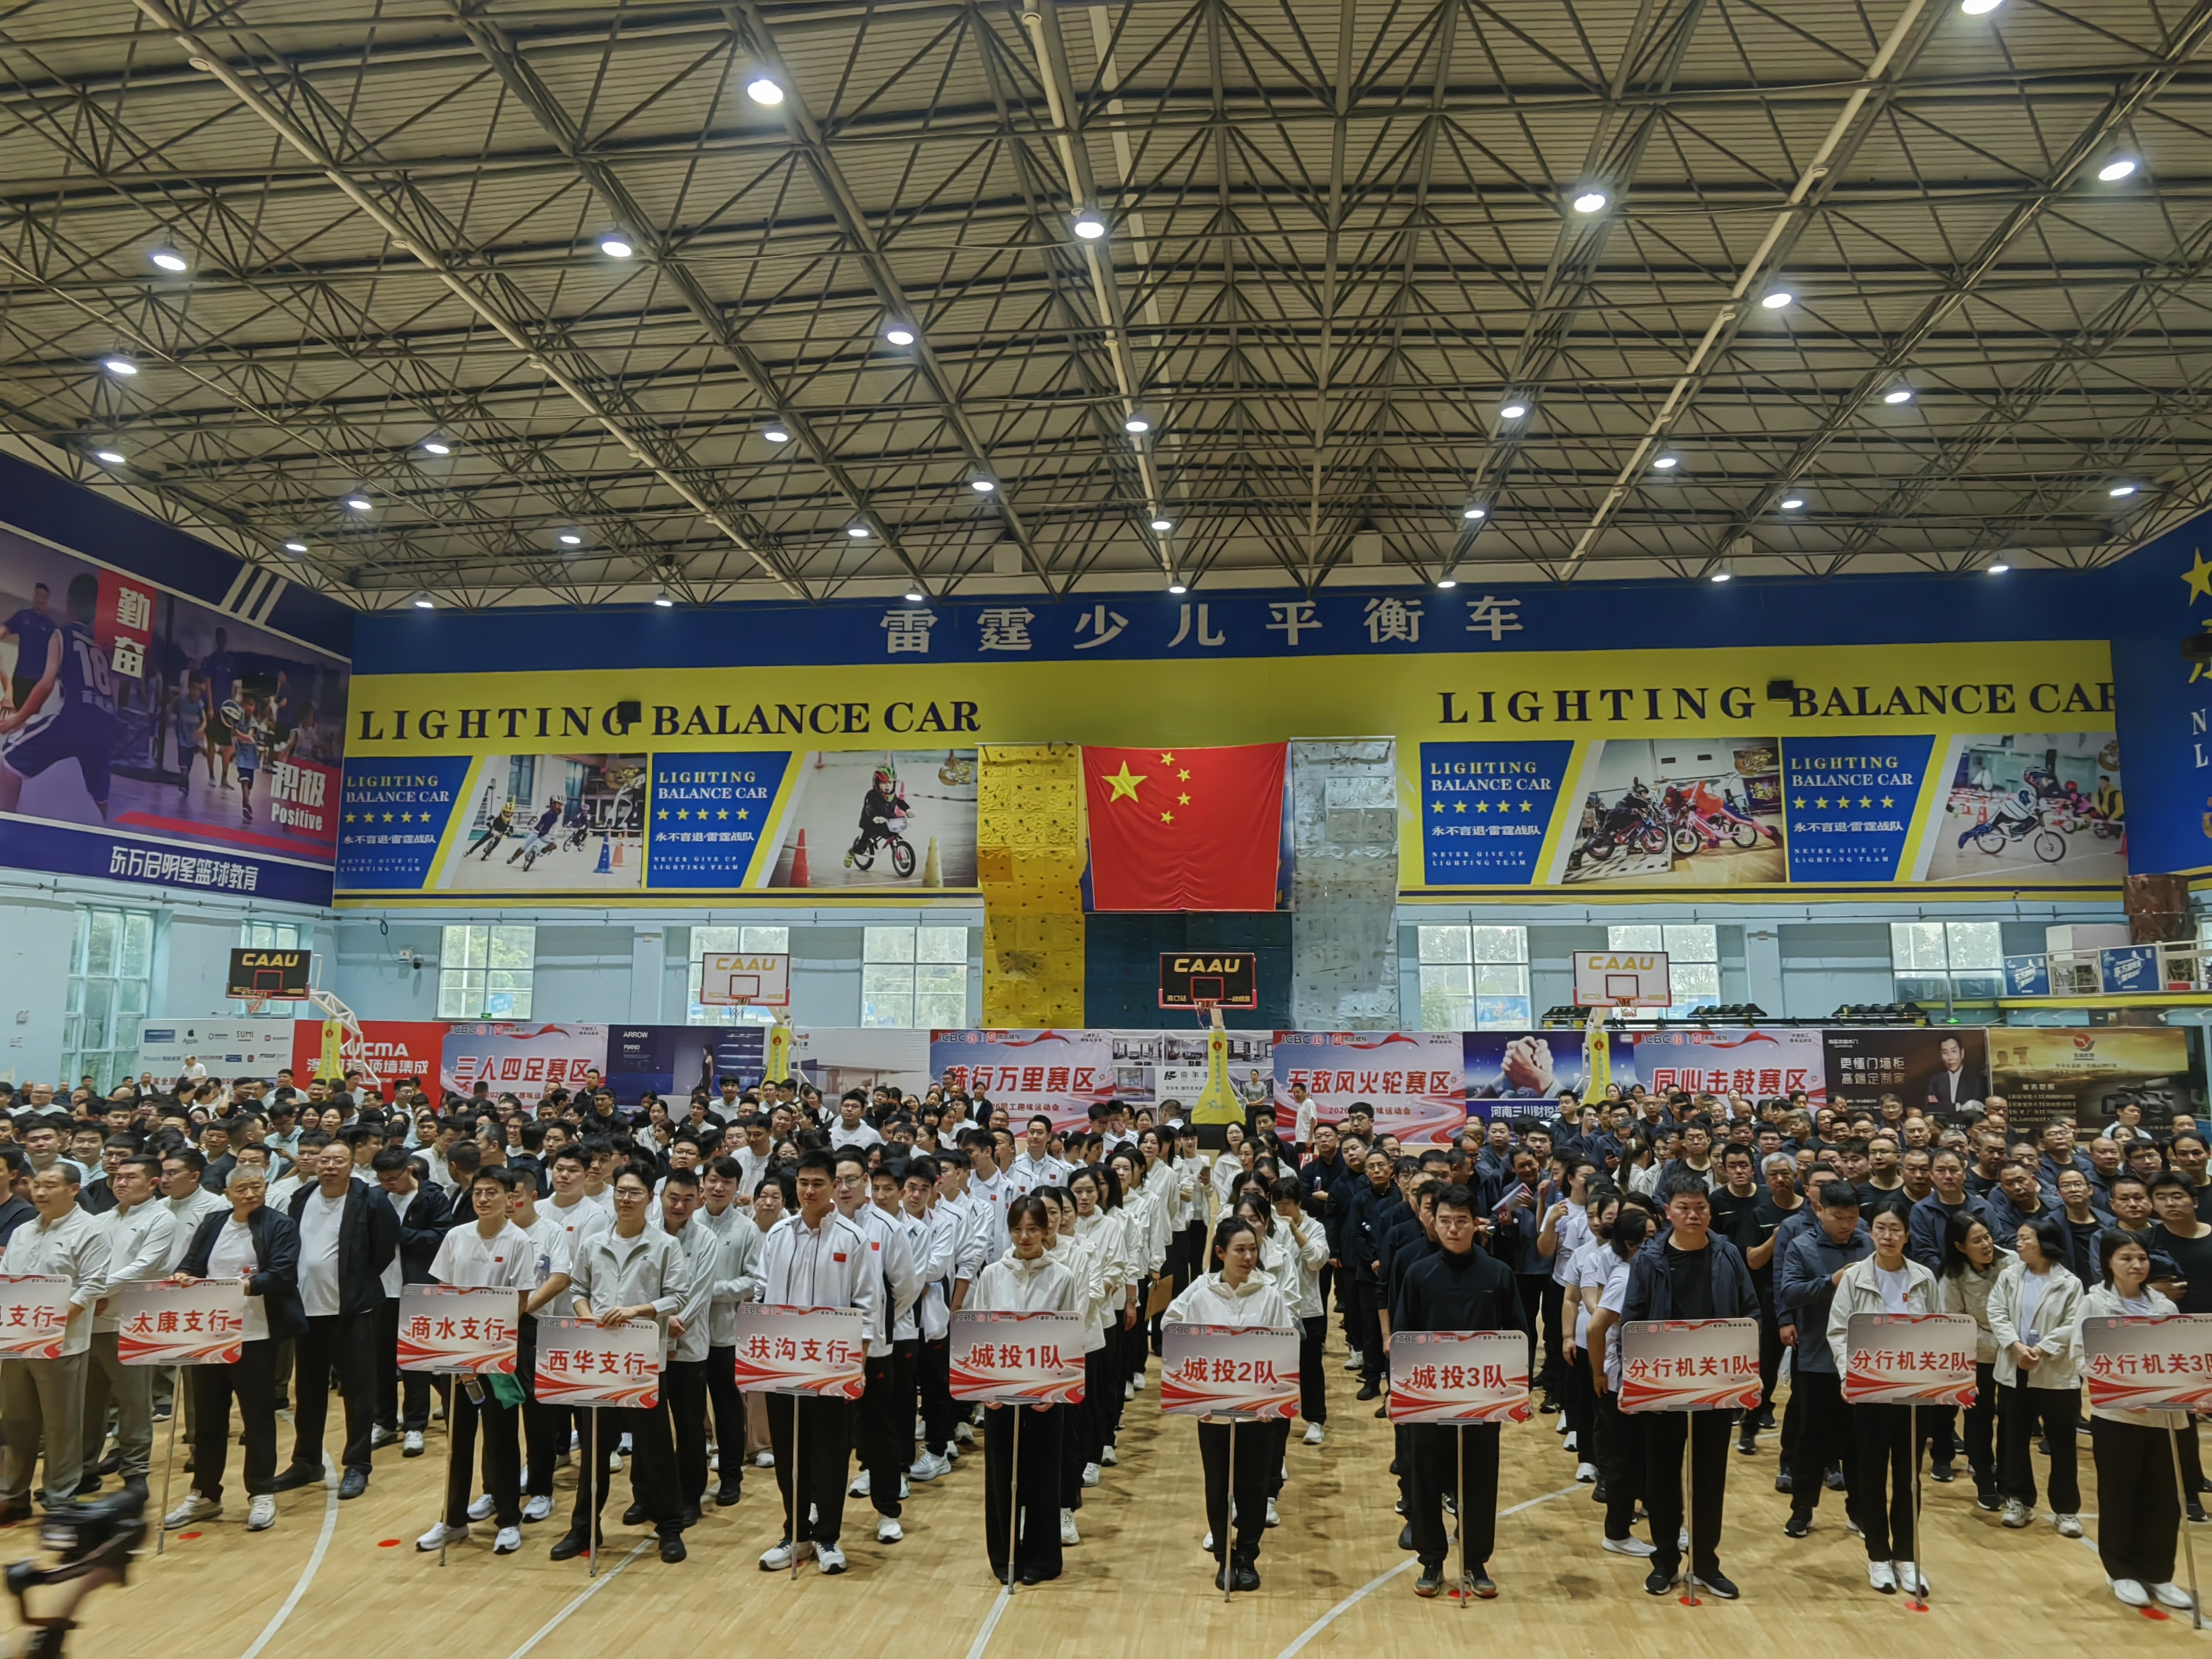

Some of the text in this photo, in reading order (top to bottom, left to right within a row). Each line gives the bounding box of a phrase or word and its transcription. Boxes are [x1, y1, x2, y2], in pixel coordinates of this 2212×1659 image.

[111, 586, 151, 679] 勤奋
[879, 595, 1524, 654] 雷霆少儿平衡车
[1437, 686, 1756, 724] LIGHTING
[1789, 683, 2016, 717] BALANCE
[357, 701, 982, 740] LIGHTING BALANCE CAR
[1430, 762, 1537, 774] LIGHTING
[1791, 757, 1898, 769] LIGHTING
[270, 760, 325, 808] 积极
[346, 776, 439, 787] LIGHTING
[659, 772, 756, 783] LIGHTING
[1431, 778, 1552, 791] BALANCE CAR
[1792, 773, 1913, 786] BALANCE CAR
[346, 791, 450, 802] BALANCE CAR
[658, 787, 768, 799] BALANCE CAR
[271, 802, 324, 831] Positive
[110, 845, 259, 891] 东方启明星篮球教育
[241, 953, 299, 967] CAAU
[716, 958, 776, 971] CAAU
[1174, 959, 1241, 973] CAAU
[1588, 956, 1654, 970] CAAU
[450, 1025, 476, 1034] ICBC
[939, 1032, 967, 1043] ICBC
[1282, 1034, 1312, 1044] ICBC
[1641, 1034, 1671, 1044] ICBC
[455, 1057, 592, 1082] 三人四足赛区
[1840, 1057, 1905, 1070] 更懂门墙柜
[1287, 1070, 1451, 1094] 无敌风火轮赛区
[1654, 1068, 1808, 1095] 同心击鼓赛区
[0, 1305, 55, 1328] 支行
[132, 1309, 230, 1334] 太康支行
[410, 1315, 506, 1342] 商水支行
[748, 1335, 851, 1363] 扶沟支行
[970, 1343, 1065, 1370] 城投1队
[548, 1350, 647, 1376] 西华支行
[1183, 1357, 1279, 1384] 城投2队
[1630, 1356, 1753, 1380] 分行机关1队
[1851, 1350, 1969, 1372] 分行机关2队
[1411, 1364, 1507, 1390] 城投3队
